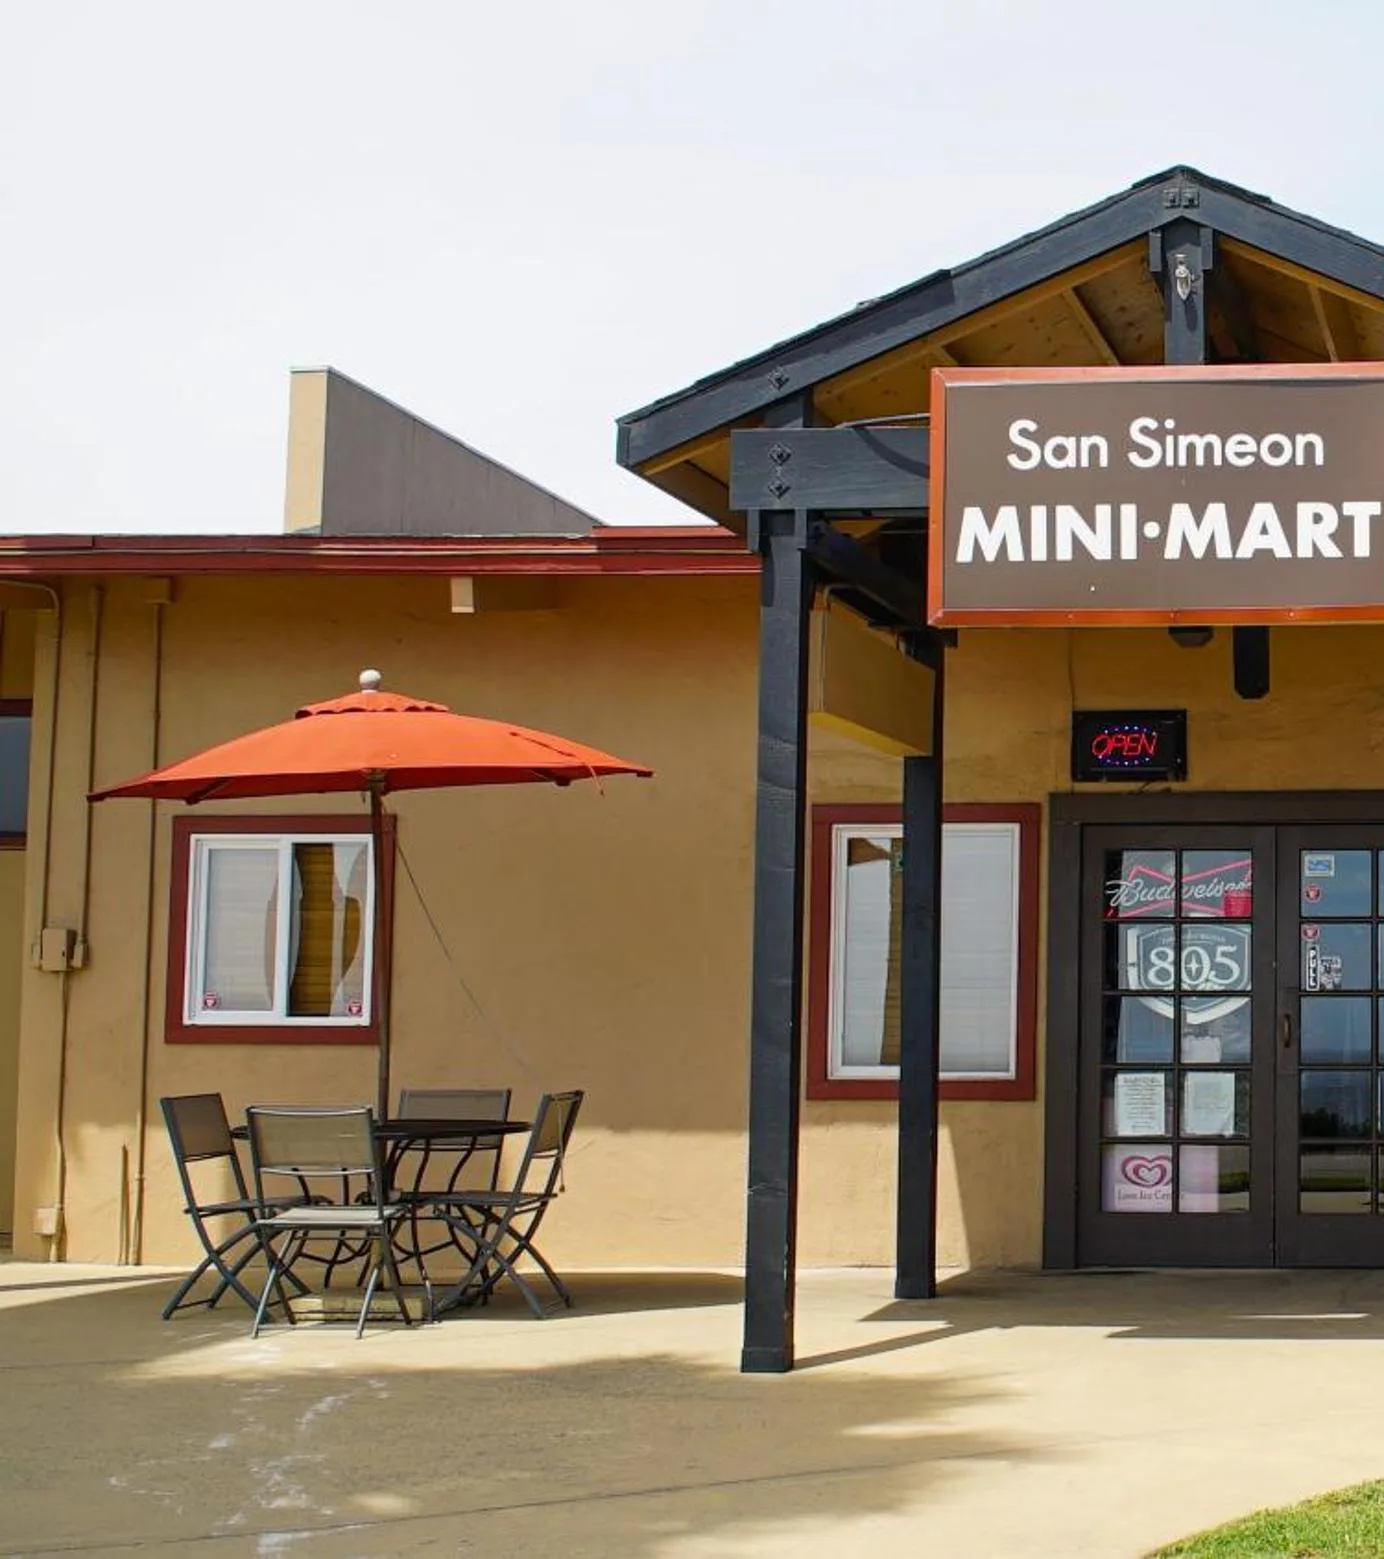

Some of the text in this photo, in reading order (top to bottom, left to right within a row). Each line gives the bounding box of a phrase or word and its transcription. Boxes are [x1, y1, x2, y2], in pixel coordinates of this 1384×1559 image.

[1006, 416, 1325, 470] San Simeon
[1091, 733, 1159, 757] OPEN
[1147, 945, 1241, 985] 805
